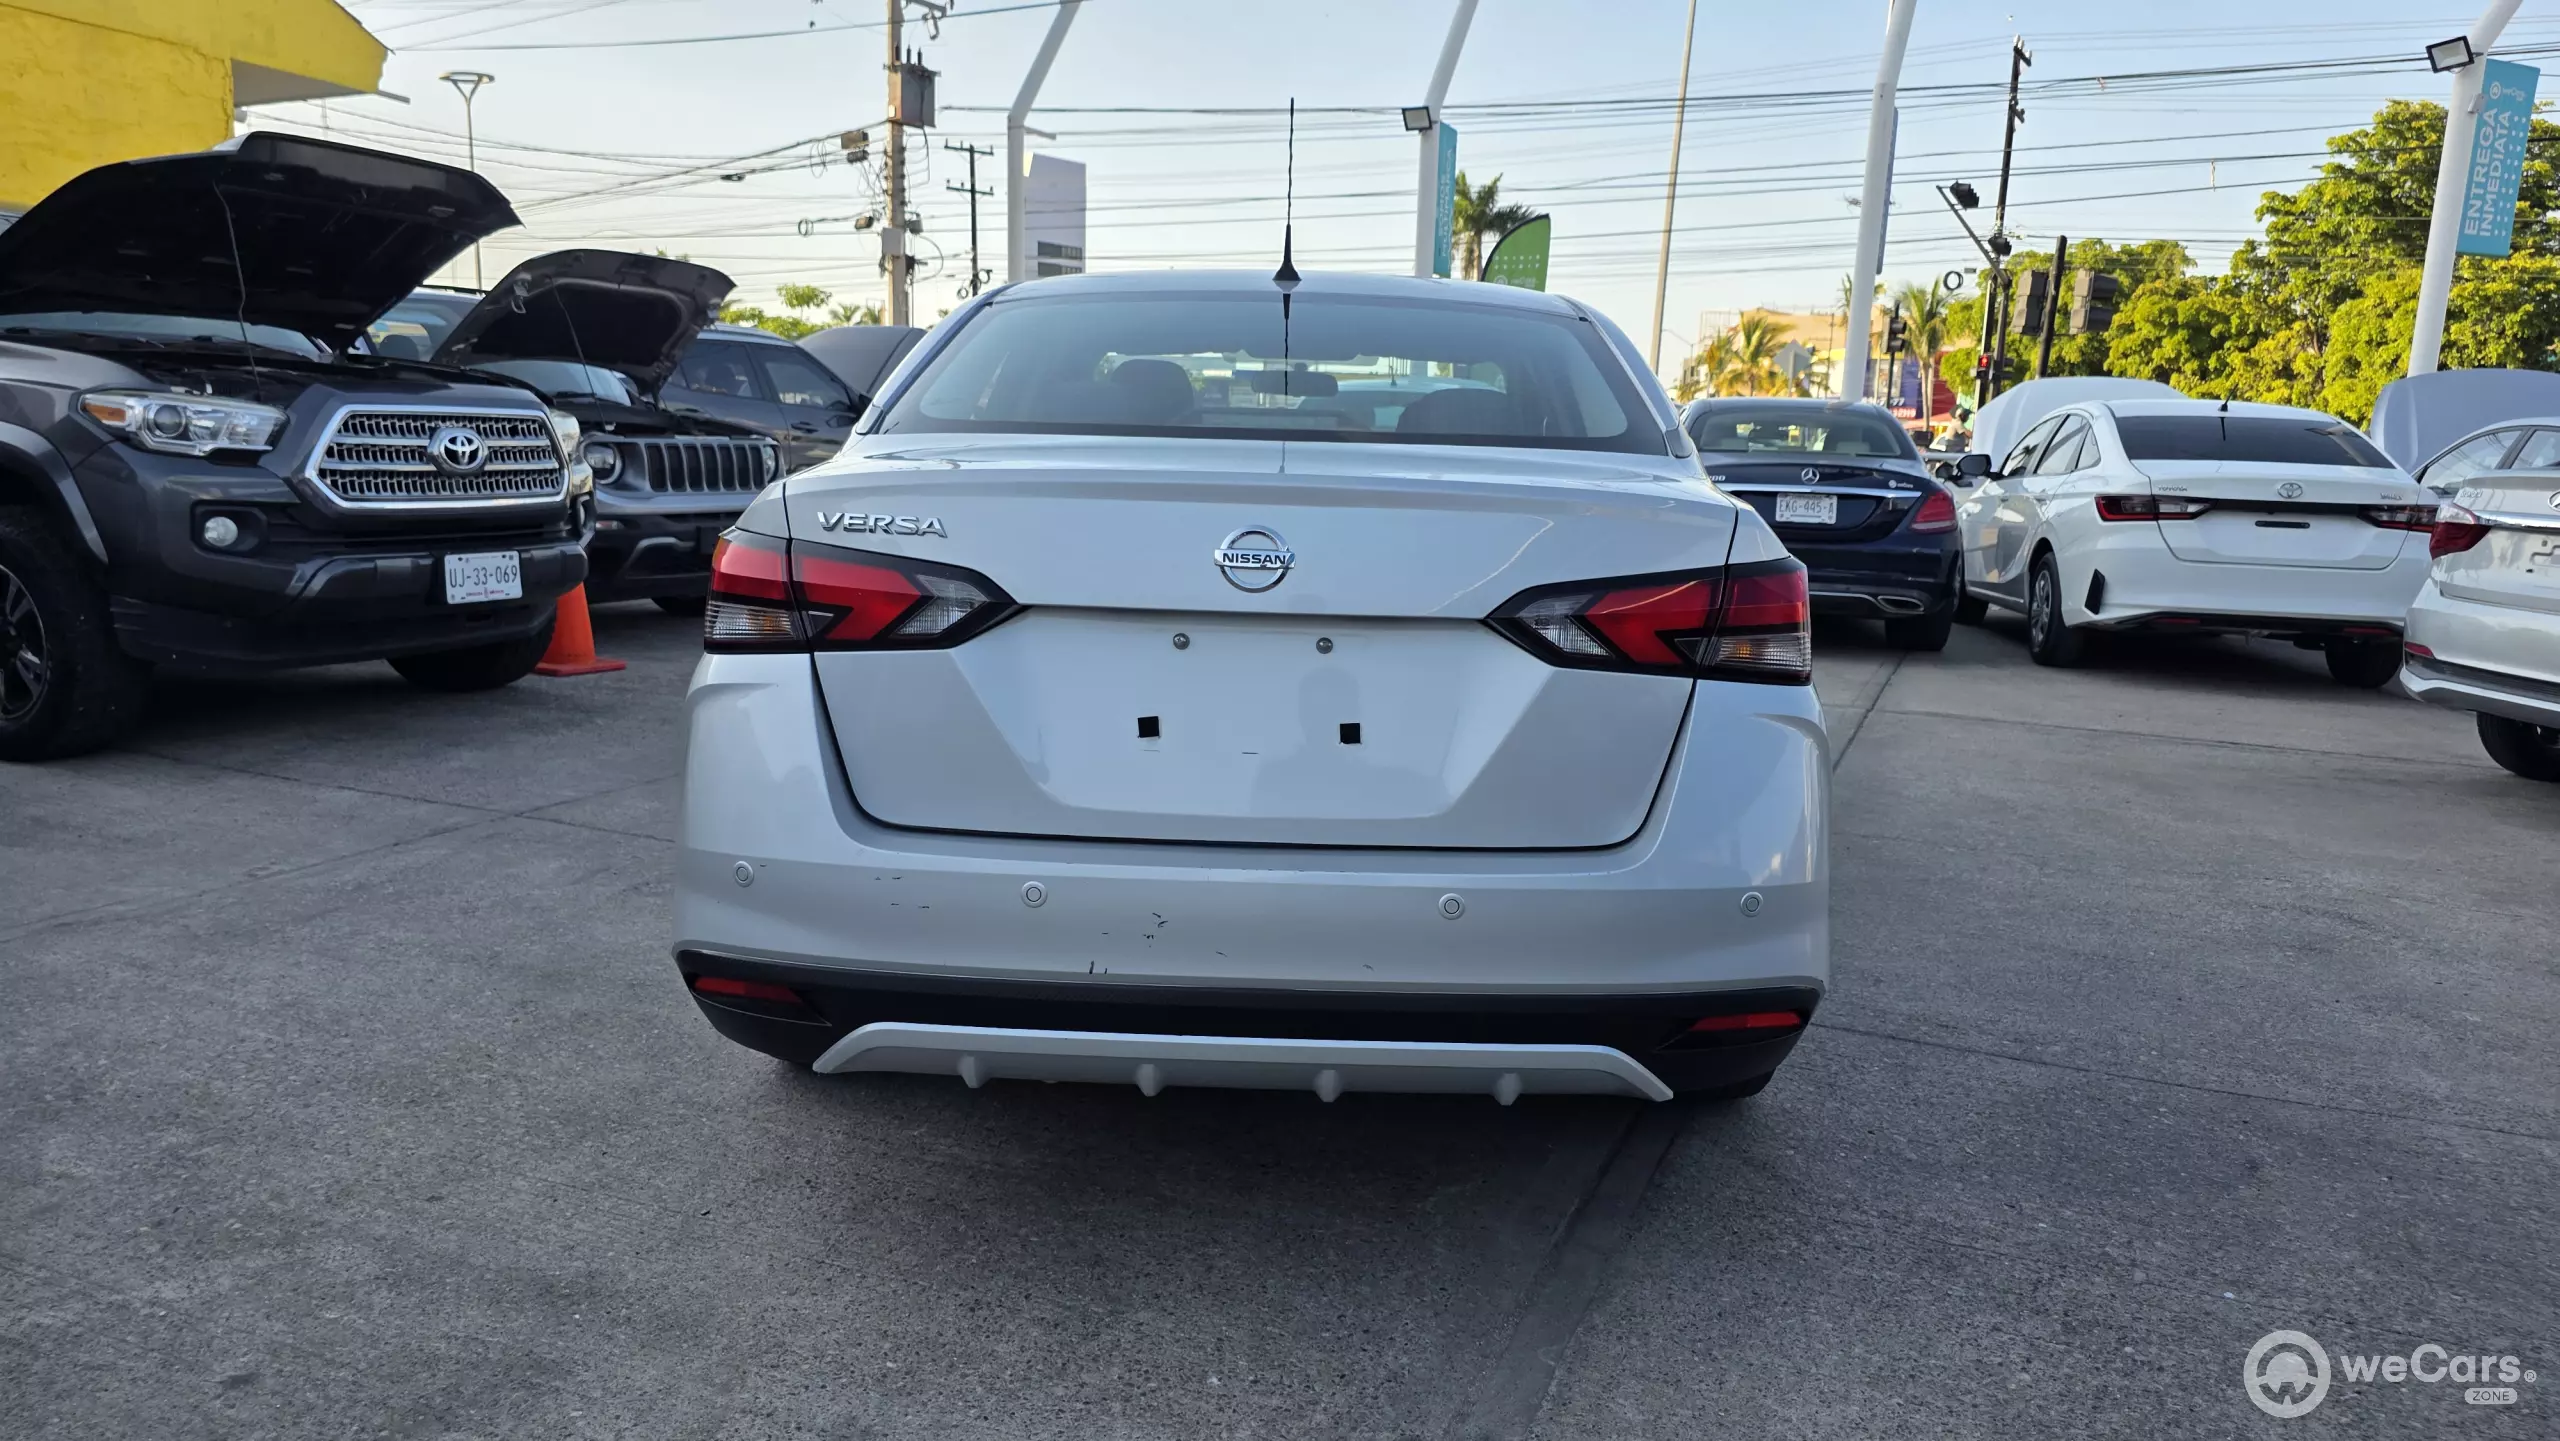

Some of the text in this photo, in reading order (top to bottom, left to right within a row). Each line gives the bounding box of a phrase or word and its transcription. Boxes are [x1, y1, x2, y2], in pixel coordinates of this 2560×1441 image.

[2464, 107, 2498, 236] ENTREGA
[2479, 110, 2511, 237] INMEDIATA
[817, 511, 948, 538] VERSA
[1222, 552, 1287, 565] NISSAN
[449, 565, 518, 588] UJ-33-069
